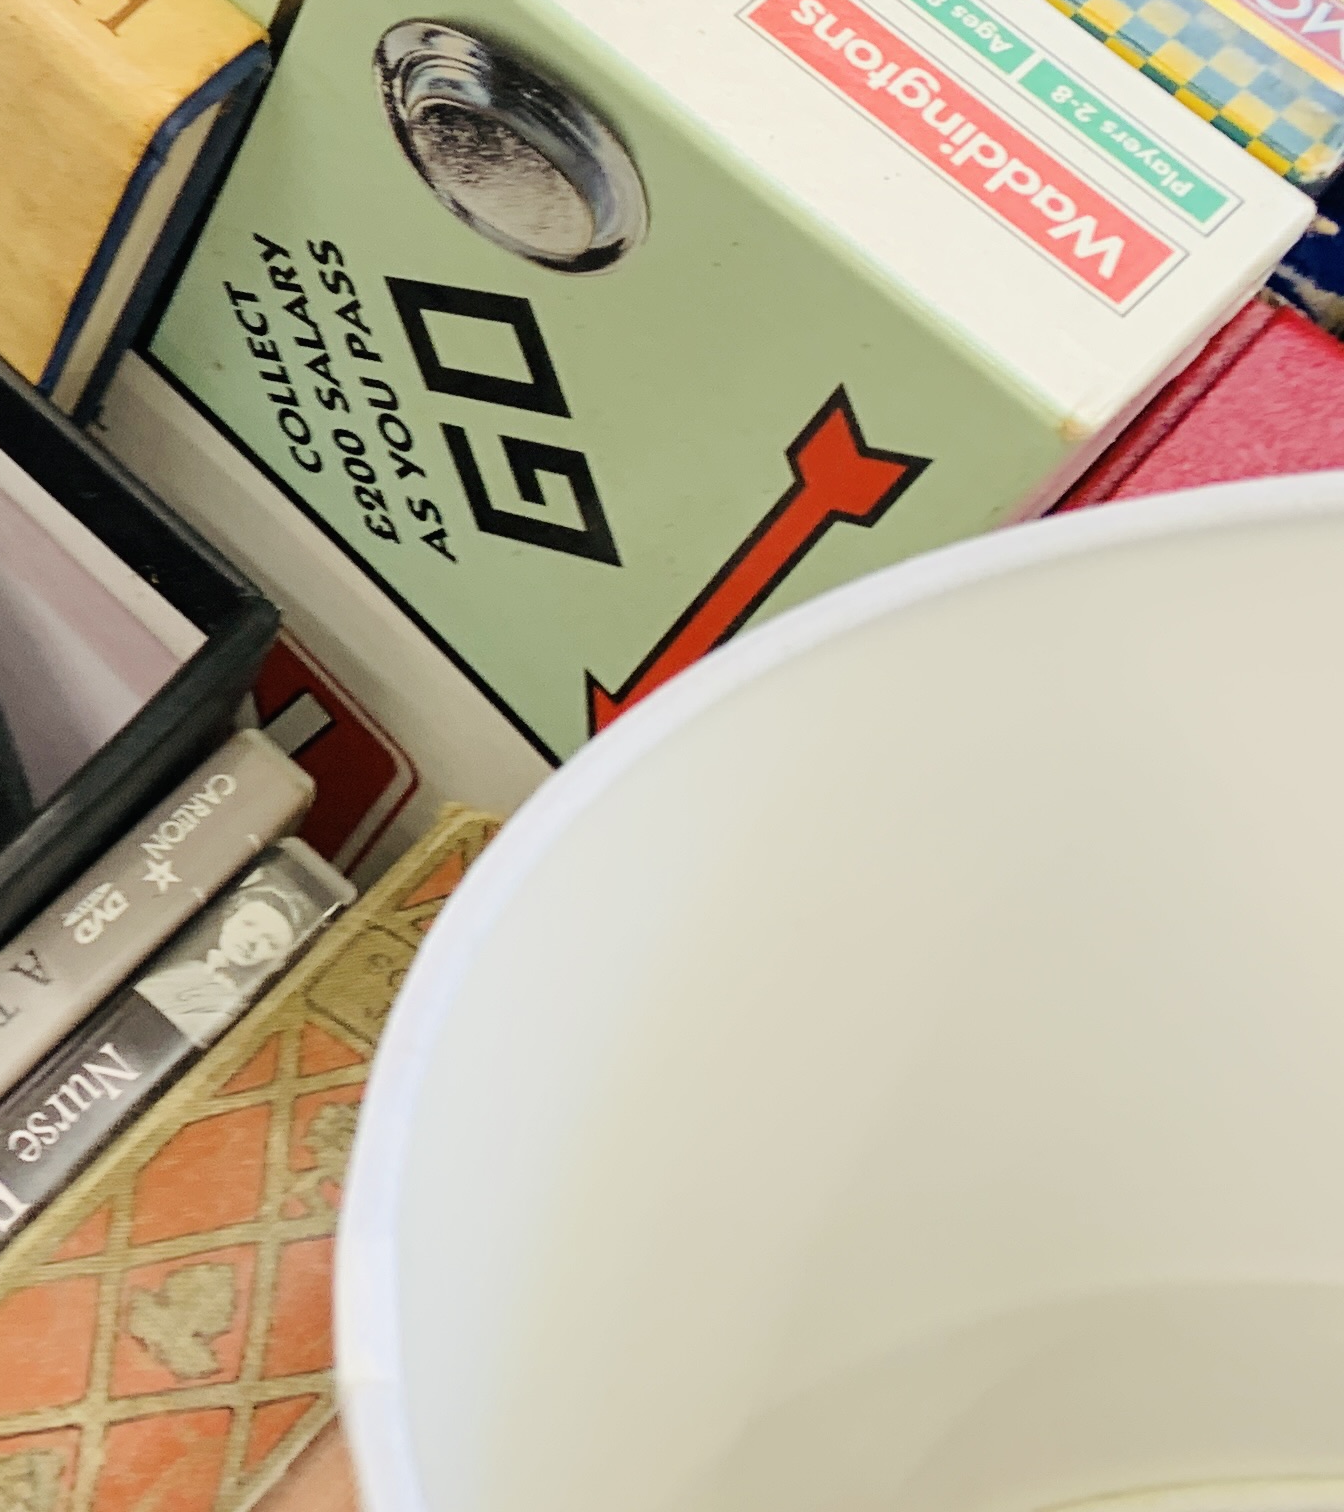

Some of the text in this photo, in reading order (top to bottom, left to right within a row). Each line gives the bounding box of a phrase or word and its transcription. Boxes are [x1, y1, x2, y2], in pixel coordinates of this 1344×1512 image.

[950, 1, 1015, 56] Ages
[1049, 83, 1098, 125] 2-8
[1098, 115, 1197, 199] Players
[222, 280, 325, 475] COLLECT
[252, 231, 402, 545] £200 SALARY
[306, 239, 459, 565] AS YOU PASS
[383, 275, 625, 569] GO
[141, 773, 237, 862] CARLTON
[73, 889, 130, 946] DVD
[10, 948, 54, 989] A
[6, 1039, 143, 1165] Nurse
